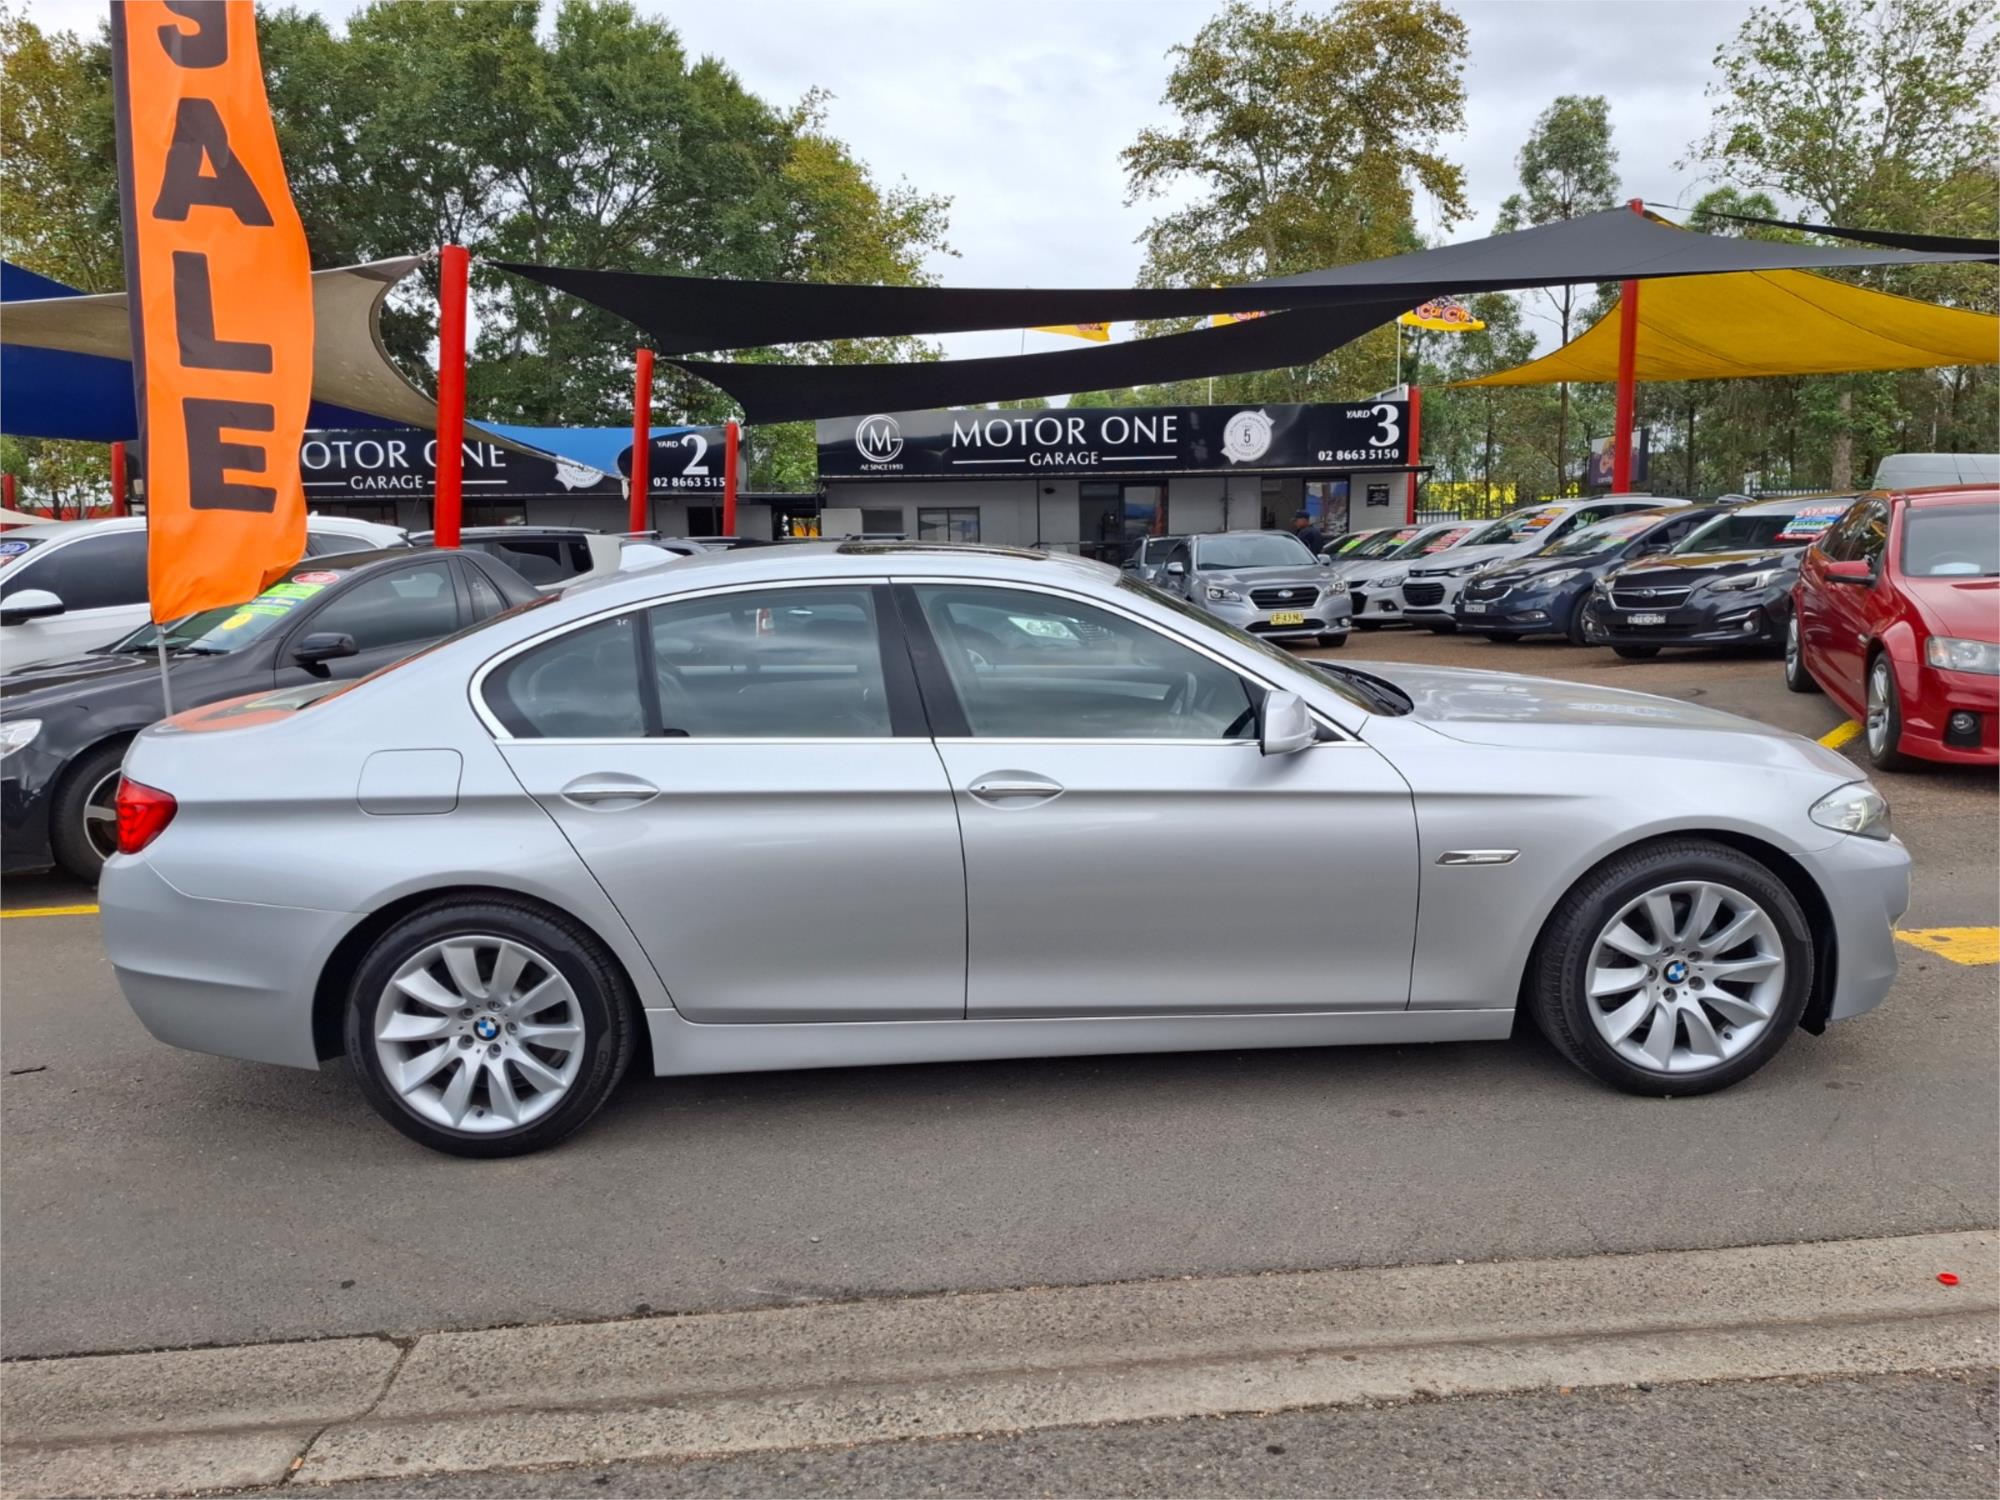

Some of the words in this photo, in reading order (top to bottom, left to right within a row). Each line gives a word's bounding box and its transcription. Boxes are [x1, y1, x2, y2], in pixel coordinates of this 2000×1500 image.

[951, 417, 1087, 448] MOTOR
[1101, 416, 1178, 445] ONE
[1346, 410, 1371, 419] YARD
[1368, 404, 1400, 447] 3
[300, 439, 410, 470] OTOR
[656, 440, 679, 449] YARD
[680, 433, 710, 476] 2
[1029, 451, 1099, 467] GARAGE
[1317, 450, 1333, 461] 02
[1336, 449, 1367, 461] 8663
[1368, 448, 1400, 460] 5150
[350, 475, 424, 490] GARAGE
[653, 476, 668, 488] 02
[671, 476, 701, 488] 8663
[704, 476, 726, 488] 515
